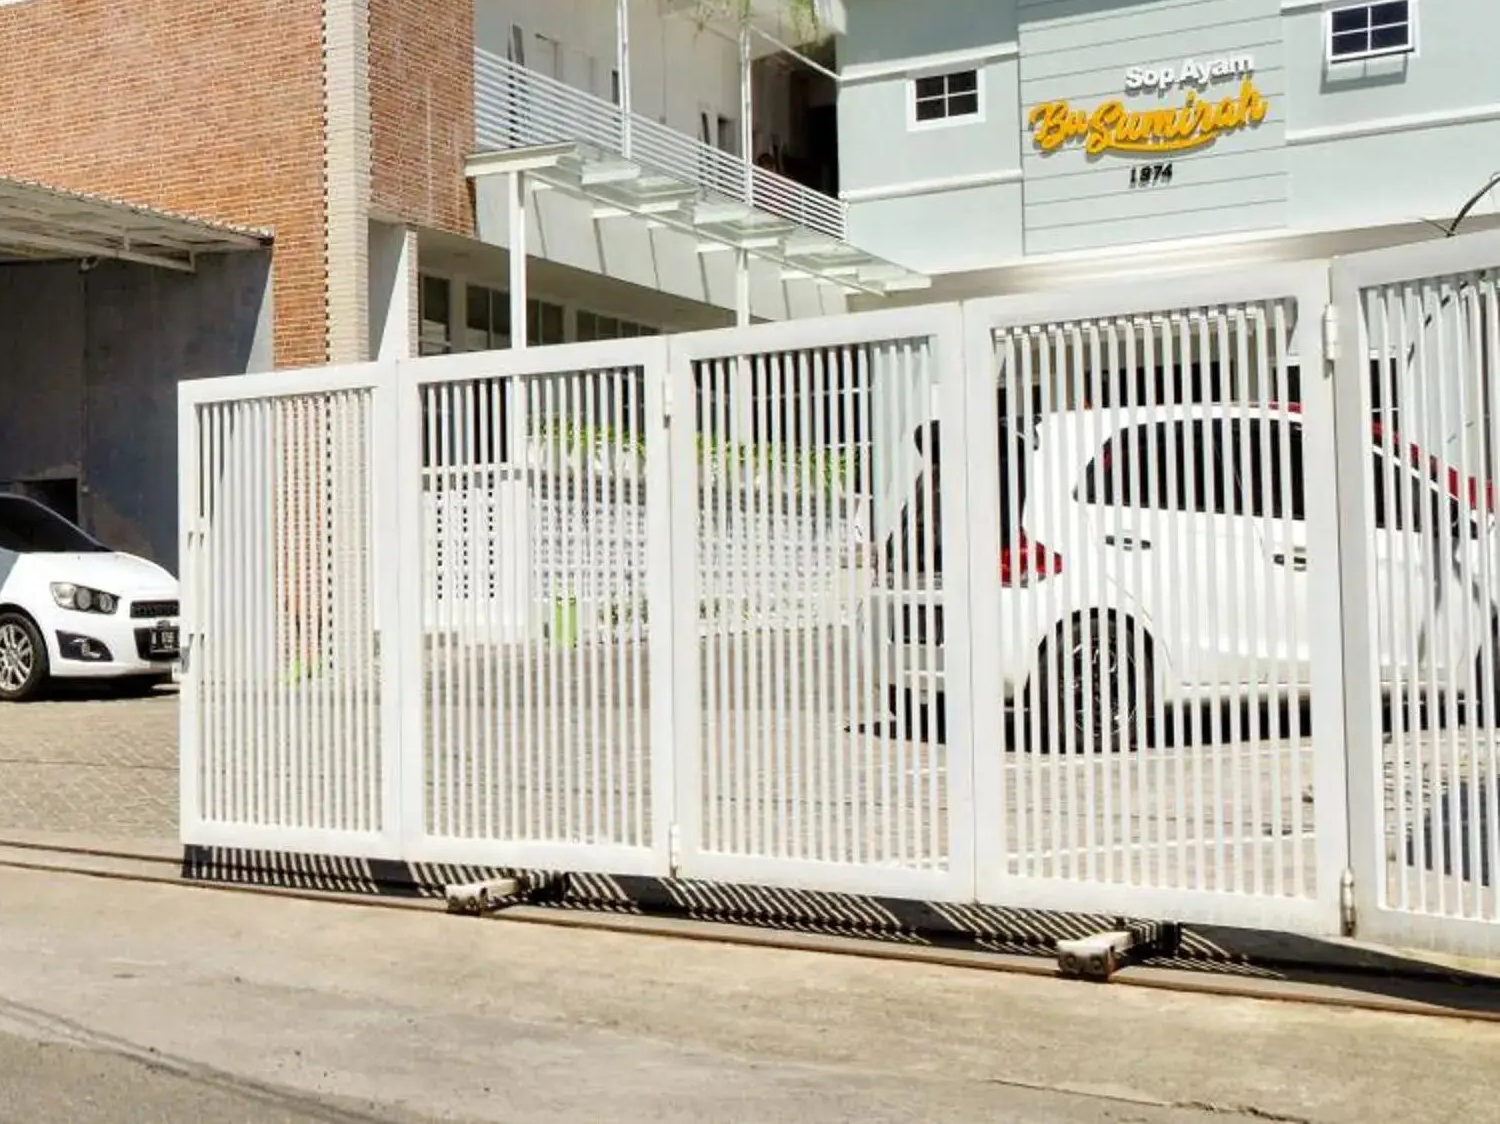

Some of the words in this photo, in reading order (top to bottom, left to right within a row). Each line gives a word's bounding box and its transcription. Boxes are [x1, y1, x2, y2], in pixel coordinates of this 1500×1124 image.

[1125, 66, 1175, 89] Sop
[1178, 55, 1253, 84] Ayam
[1029, 99, 1088, 149] Bu
[1086, 76, 1268, 154] Sumirah
